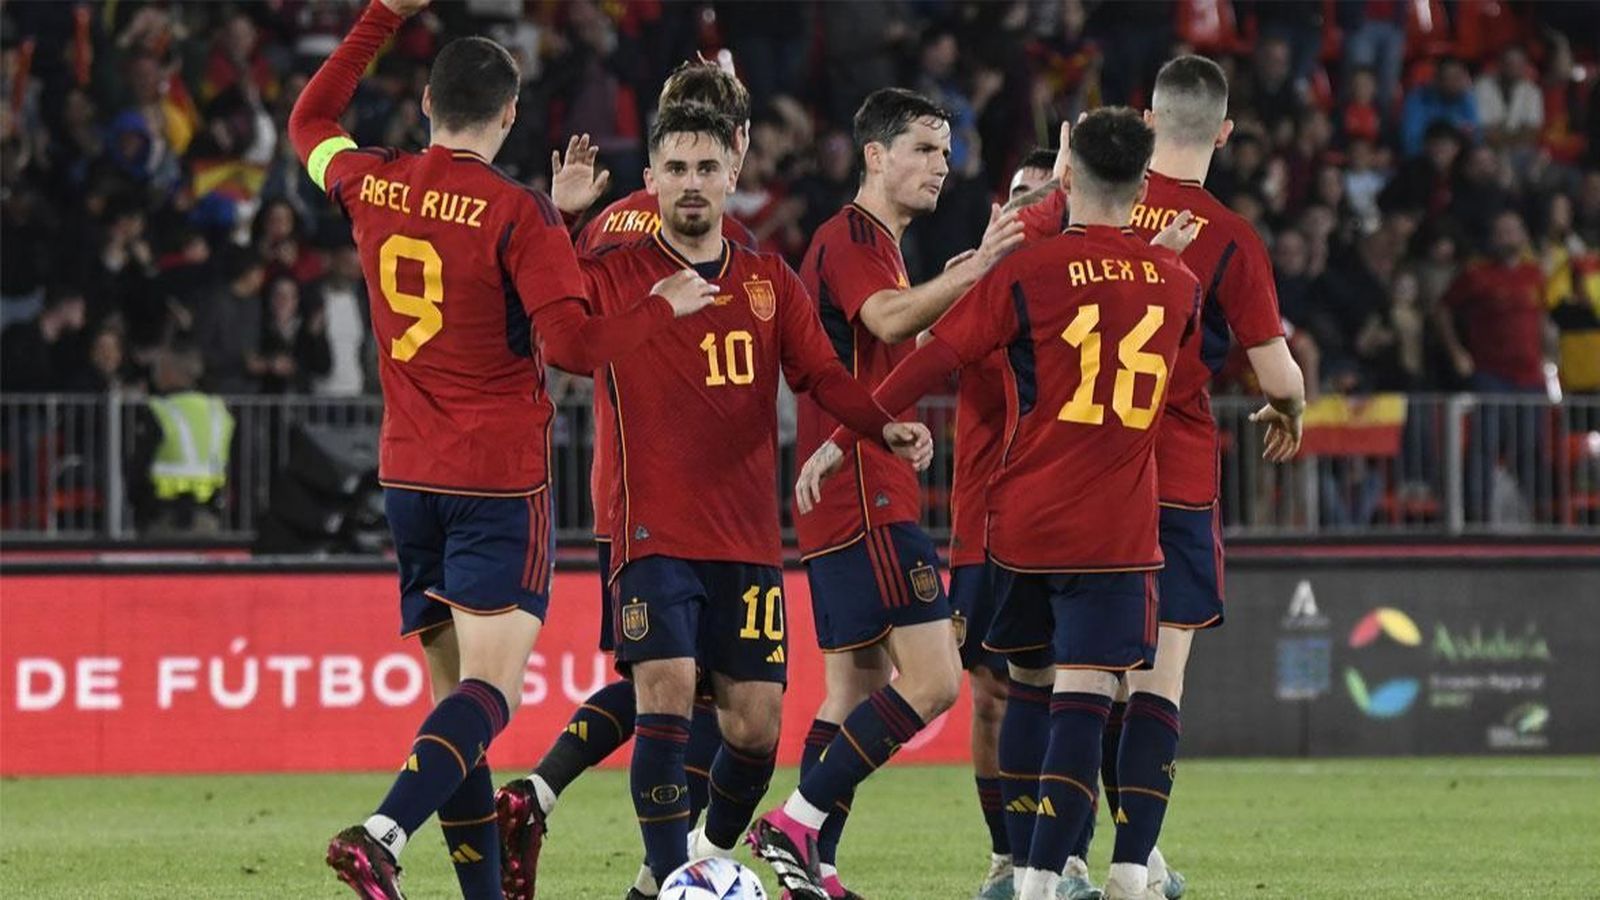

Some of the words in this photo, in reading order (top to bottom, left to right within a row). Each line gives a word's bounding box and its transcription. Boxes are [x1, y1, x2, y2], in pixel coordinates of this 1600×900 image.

[360, 174, 411, 214] ABEL
[420, 190, 488, 228] RUIZ
[1129, 204, 1209, 241] ANCT
[380, 234, 443, 362] 9
[1068, 259, 1135, 286] ALEX
[1142, 261, 1166, 284] B.
[700, 330, 754, 386] 10
[1057, 303, 1168, 430] 16
[739, 585, 784, 640] 10
[16, 657, 122, 710] DE
[157, 636, 424, 710] FÚTBO
